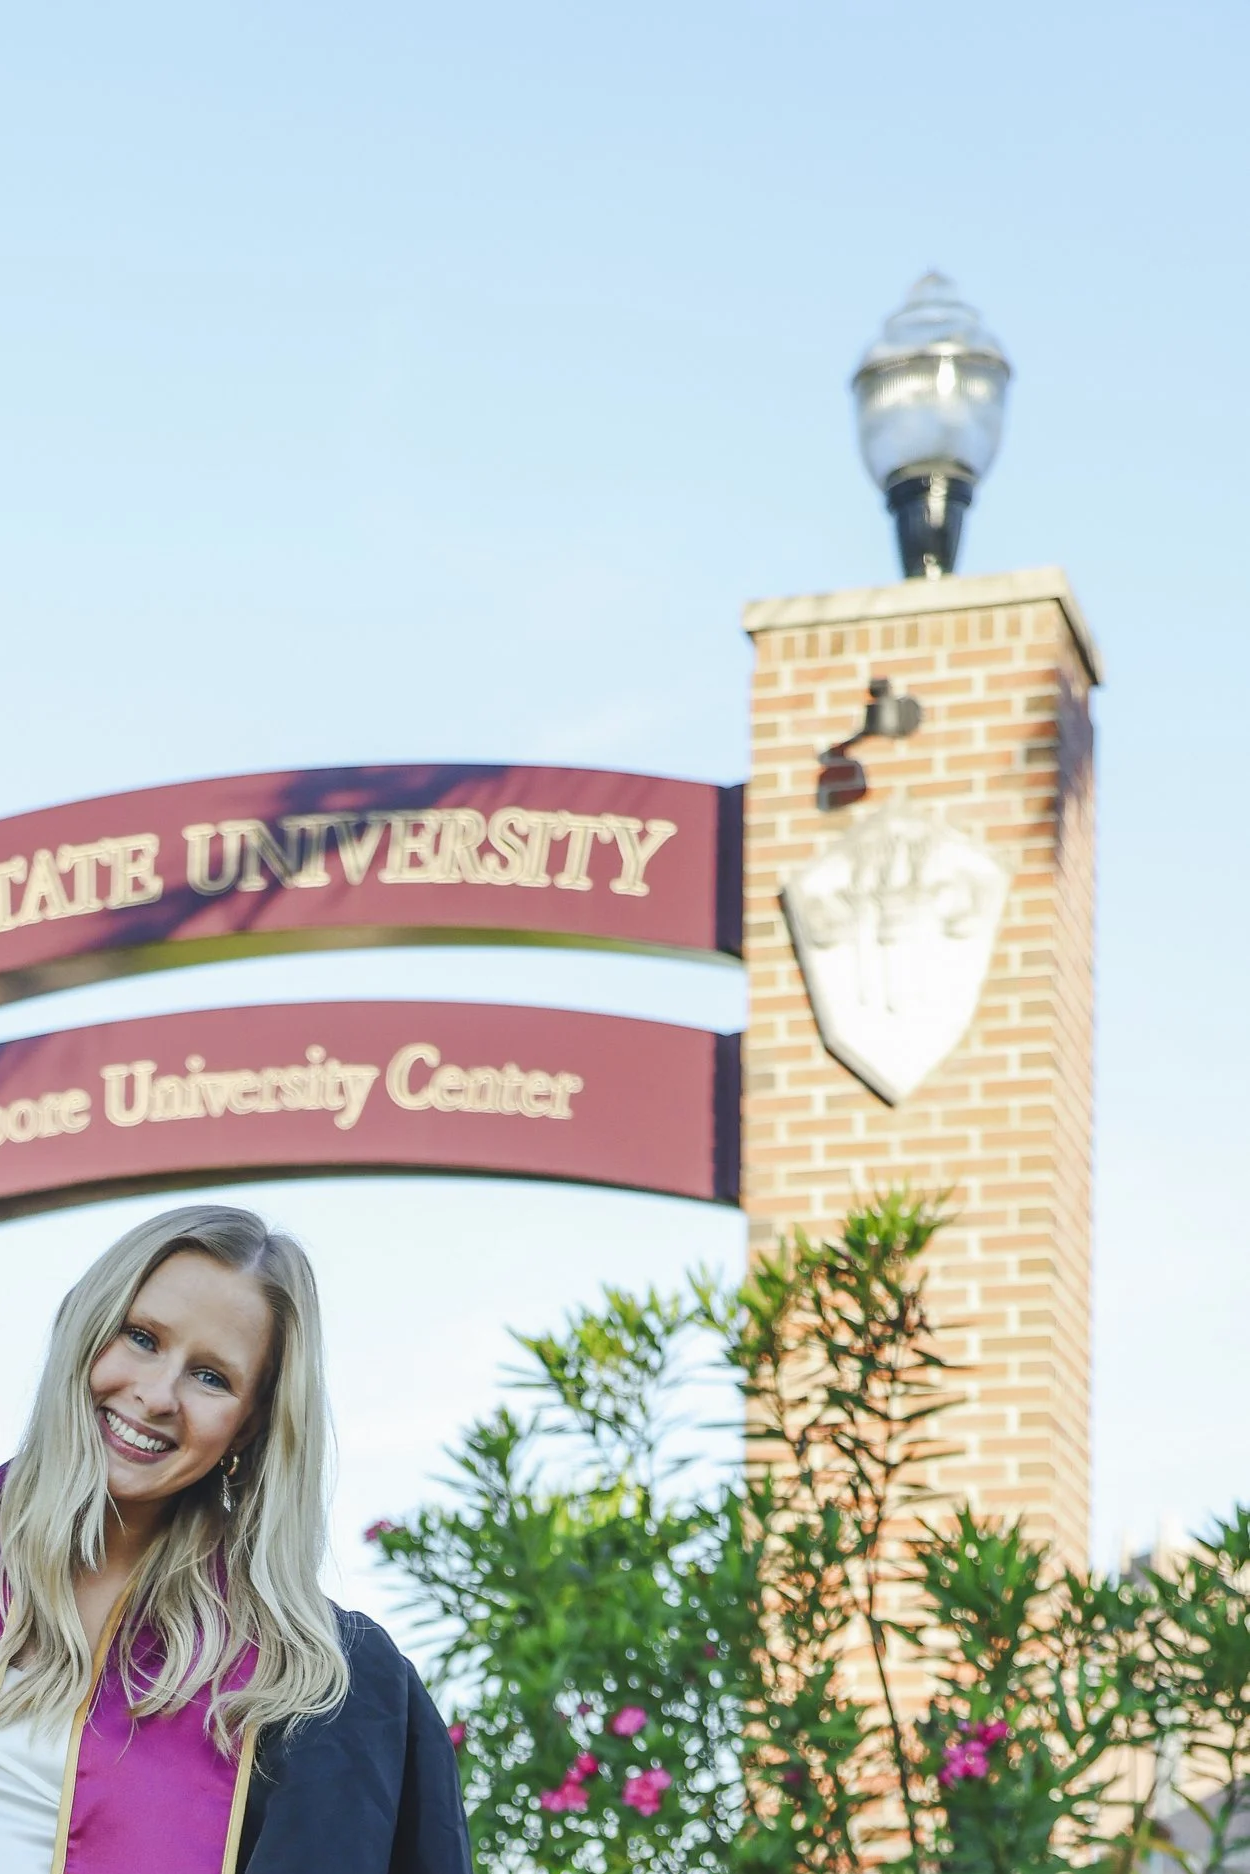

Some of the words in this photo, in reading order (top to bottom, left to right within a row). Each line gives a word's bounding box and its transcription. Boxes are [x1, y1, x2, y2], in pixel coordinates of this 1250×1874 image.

[181, 807, 678, 897] UNIVERSITY
[100, 1045, 379, 1130] University
[386, 1042, 584, 1120] Center
